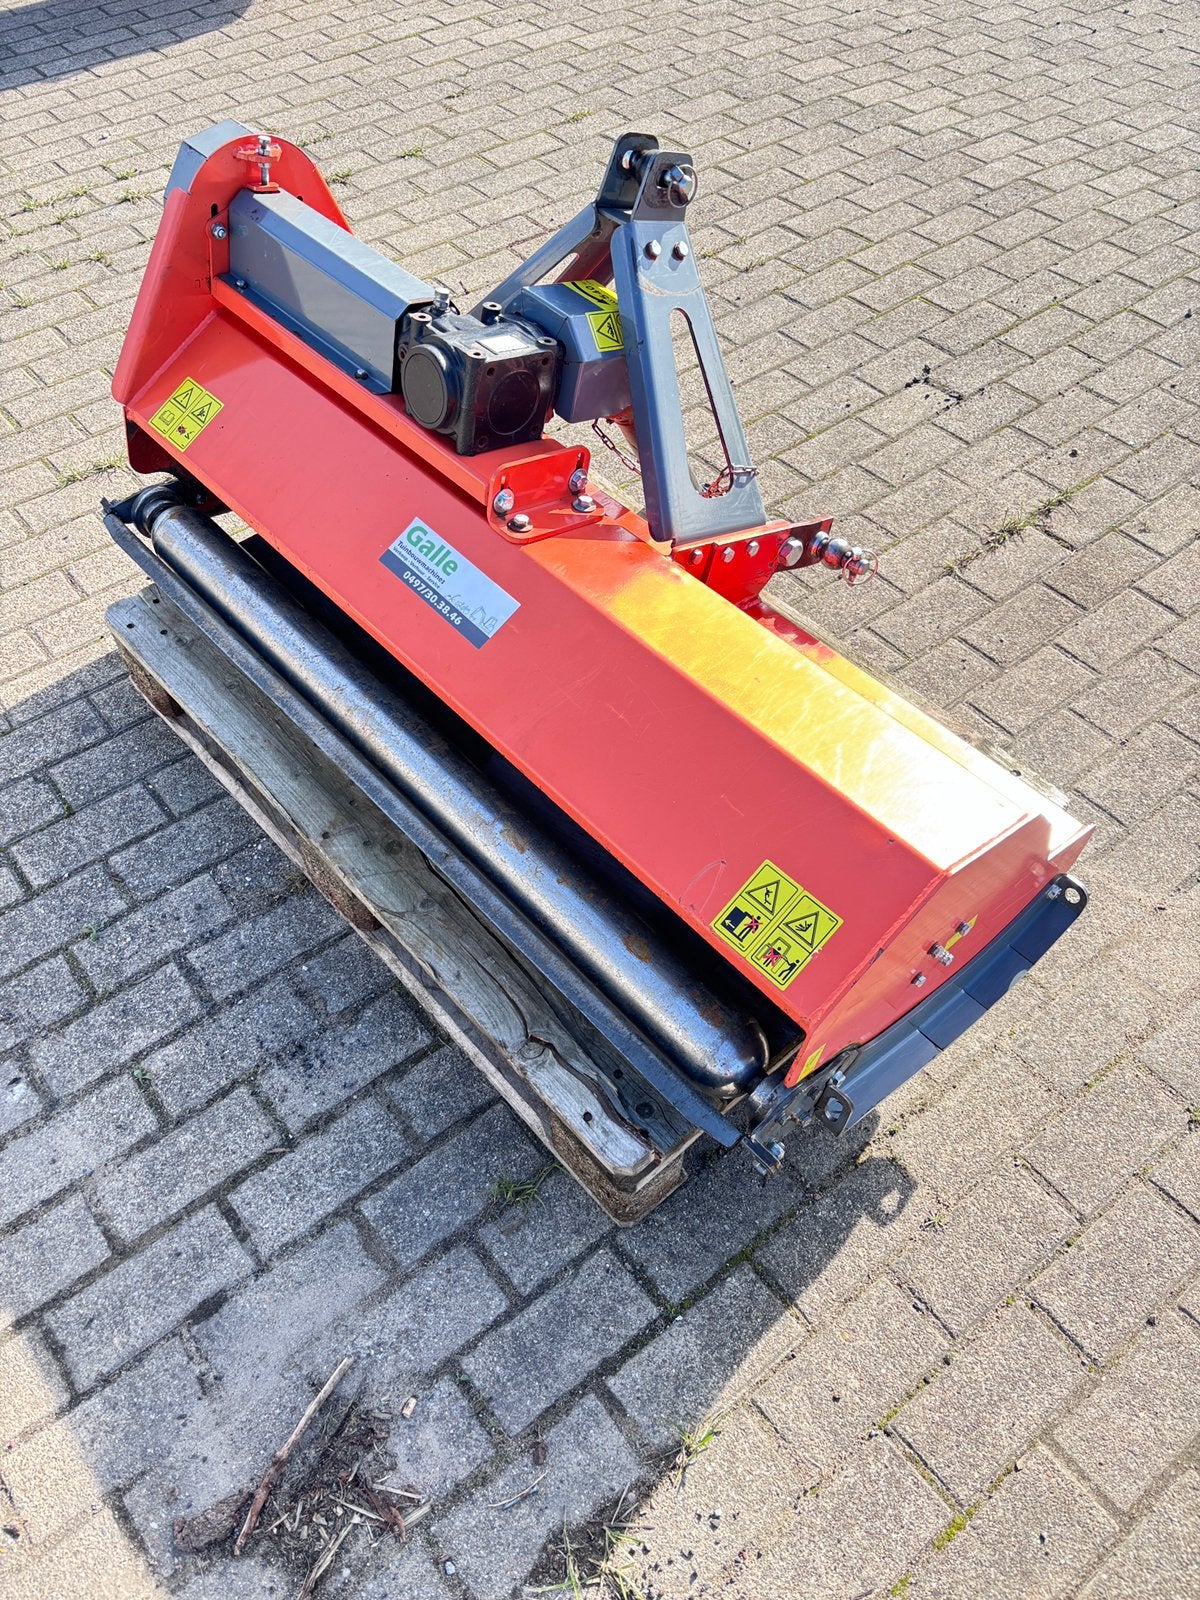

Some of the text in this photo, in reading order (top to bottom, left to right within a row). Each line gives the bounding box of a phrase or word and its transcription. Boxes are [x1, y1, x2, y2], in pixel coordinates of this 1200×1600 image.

[397, 540, 446, 584] Tuinbouwmachines
[406, 525, 458, 576] Galle
[403, 571, 463, 625] 0497/30.38.46
[425, 576, 440, 589] Service
